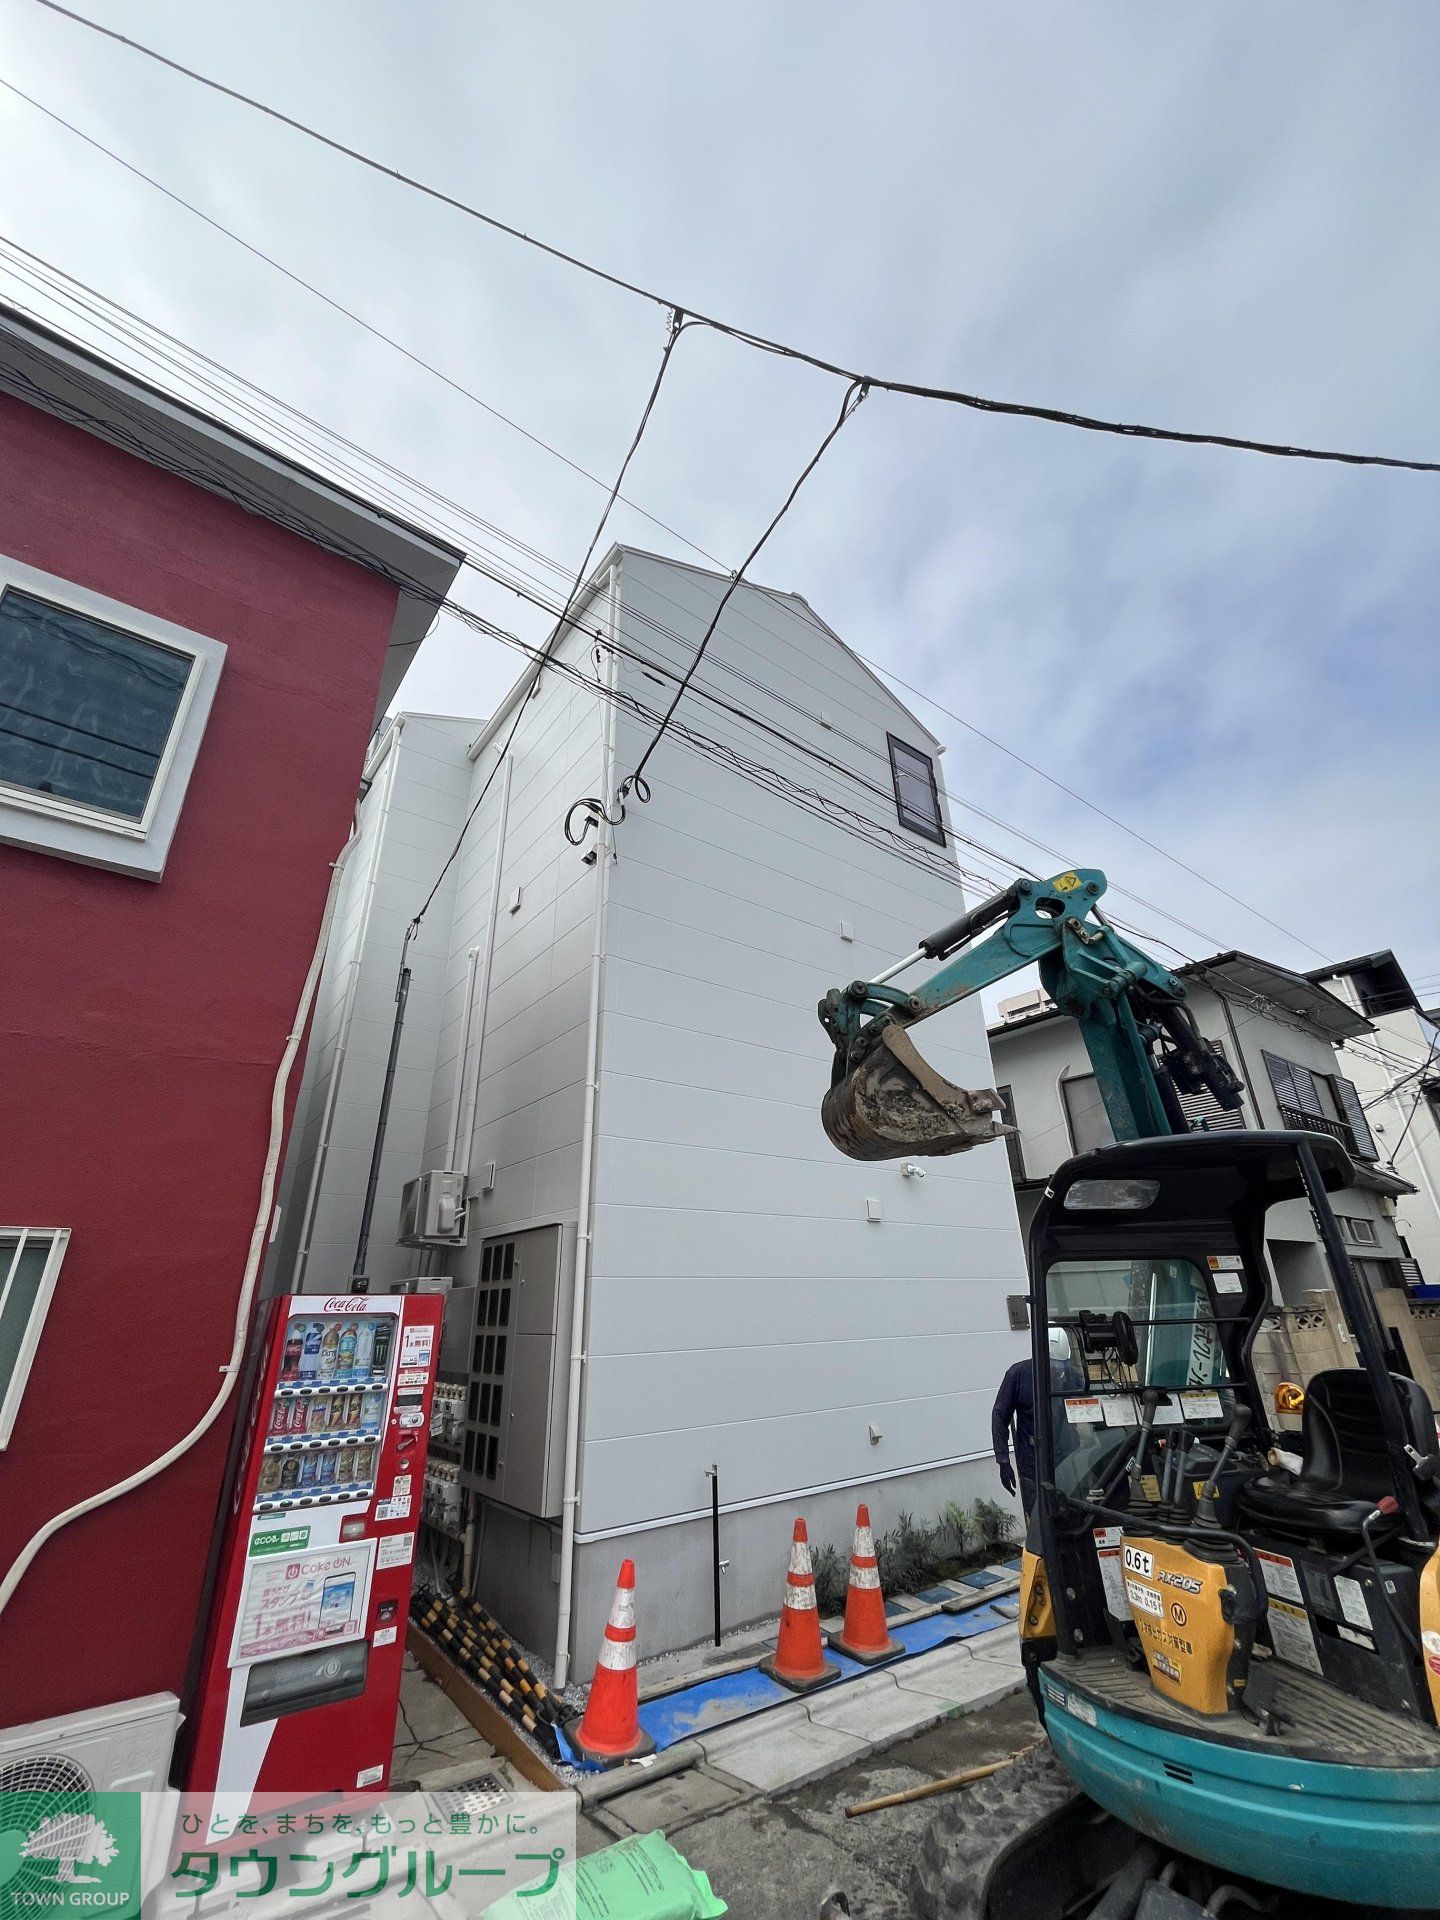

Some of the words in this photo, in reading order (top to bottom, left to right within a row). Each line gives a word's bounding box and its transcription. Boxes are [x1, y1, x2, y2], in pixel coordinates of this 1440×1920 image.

[324, 1297, 369, 1312] Coca-Cola
[302, 1561, 331, 1575] Coke
[1126, 1548, 1150, 1574] 0.6t
